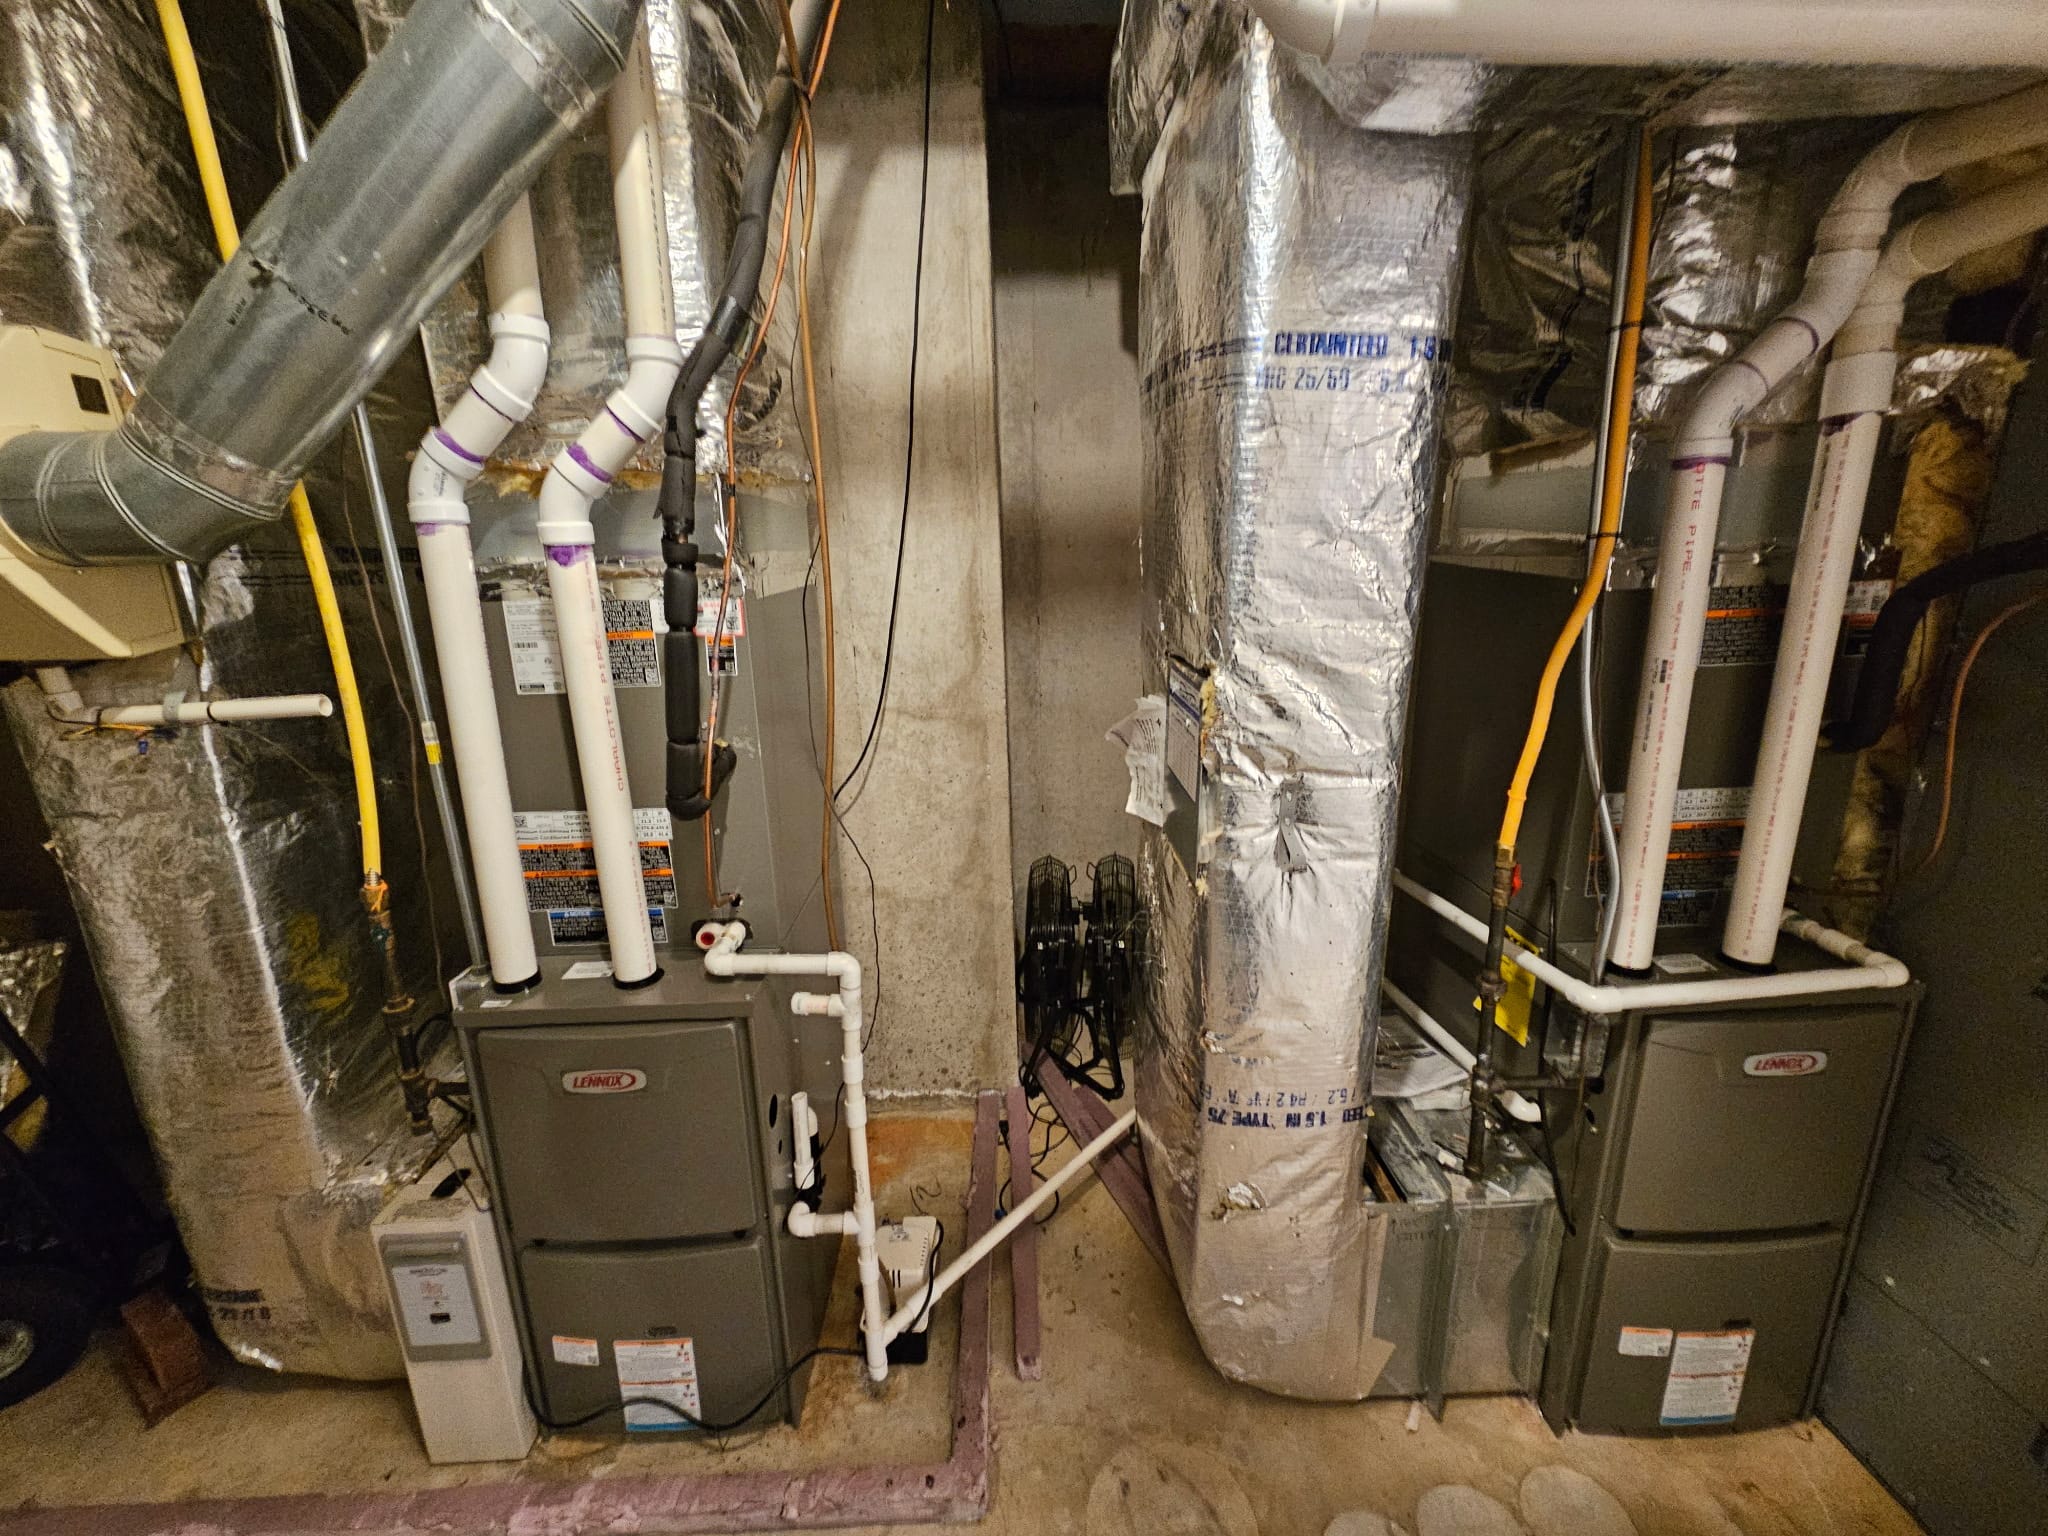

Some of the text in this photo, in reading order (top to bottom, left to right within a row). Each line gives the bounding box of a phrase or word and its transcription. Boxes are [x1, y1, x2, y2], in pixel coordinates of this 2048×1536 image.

[1682, 525, 1697, 573] PIPE
[594, 638, 625, 792] CHARLOTTE PIPE
[1754, 1057, 1806, 1071] LENNOX
[573, 1074, 625, 1089] LENNOX
[1286, 1113, 1300, 1128] IN
